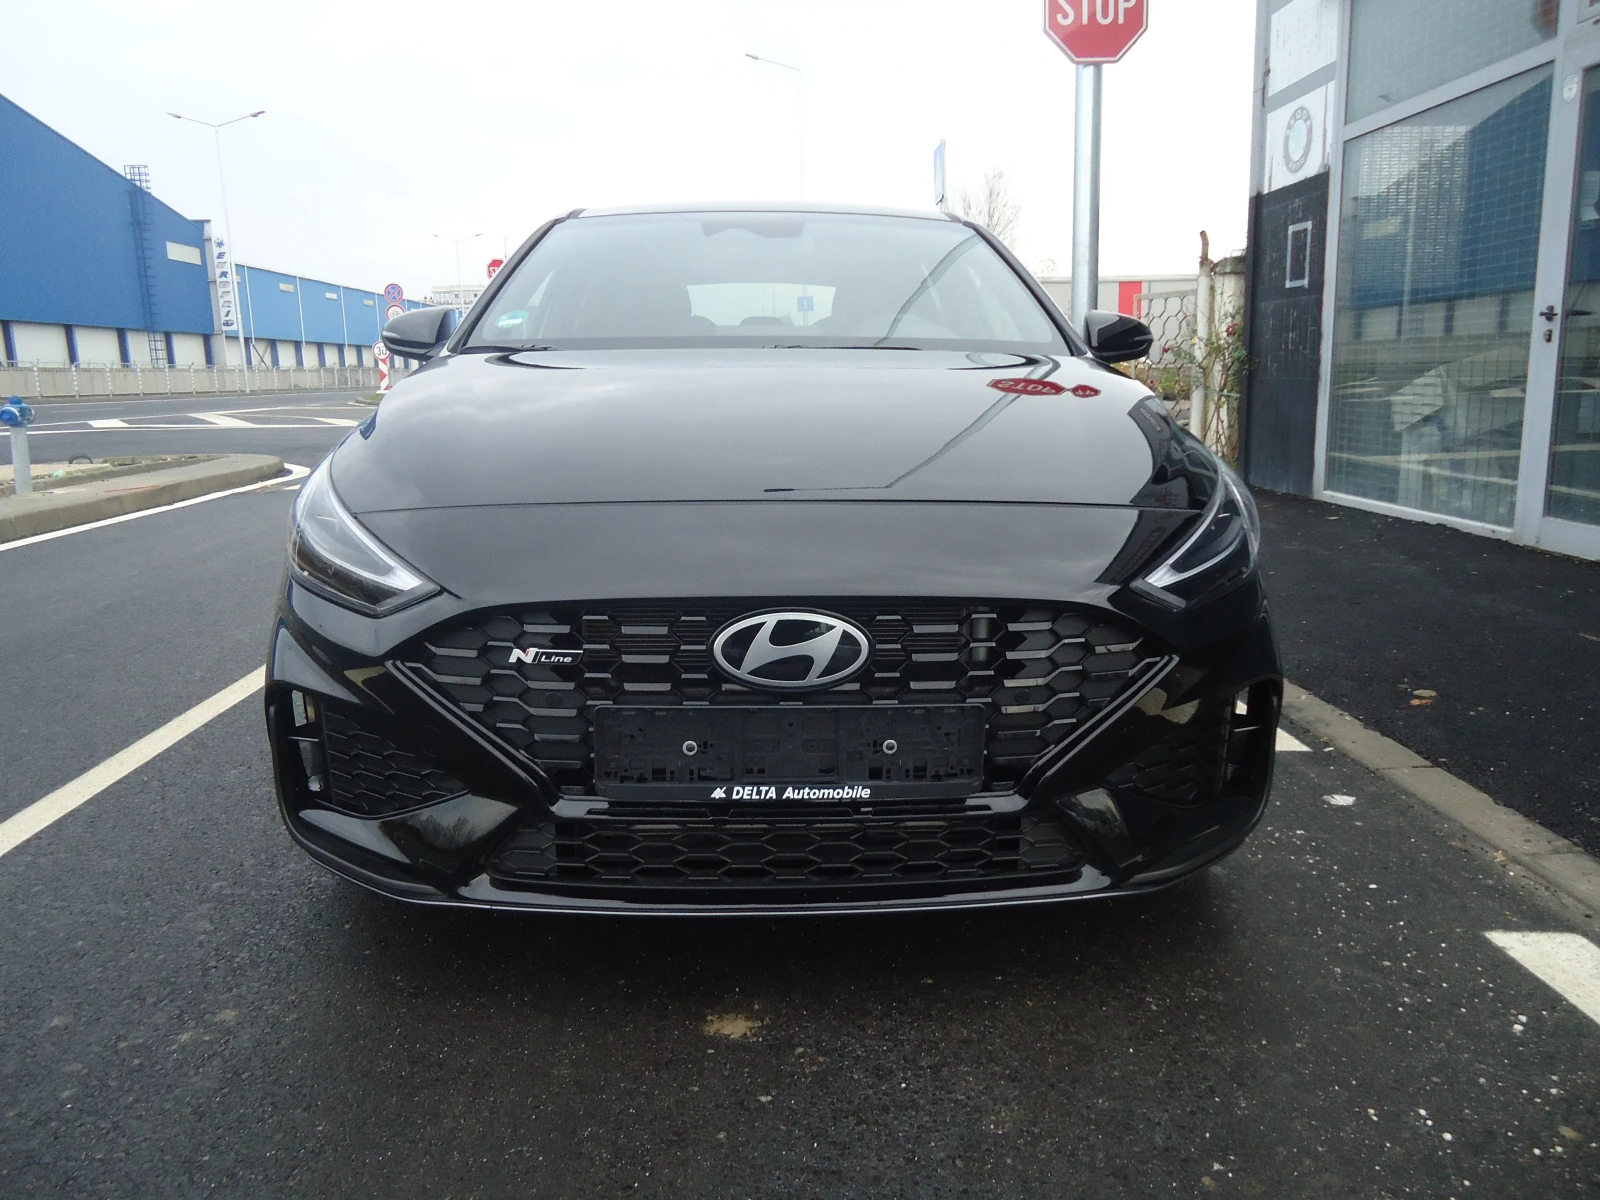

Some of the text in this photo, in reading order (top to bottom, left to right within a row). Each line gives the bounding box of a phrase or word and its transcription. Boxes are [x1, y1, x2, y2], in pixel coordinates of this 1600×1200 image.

[376, 345, 388, 356] 30
[508, 647, 572, 664] N Line
[732, 785, 871, 799] DELTA Automobile
